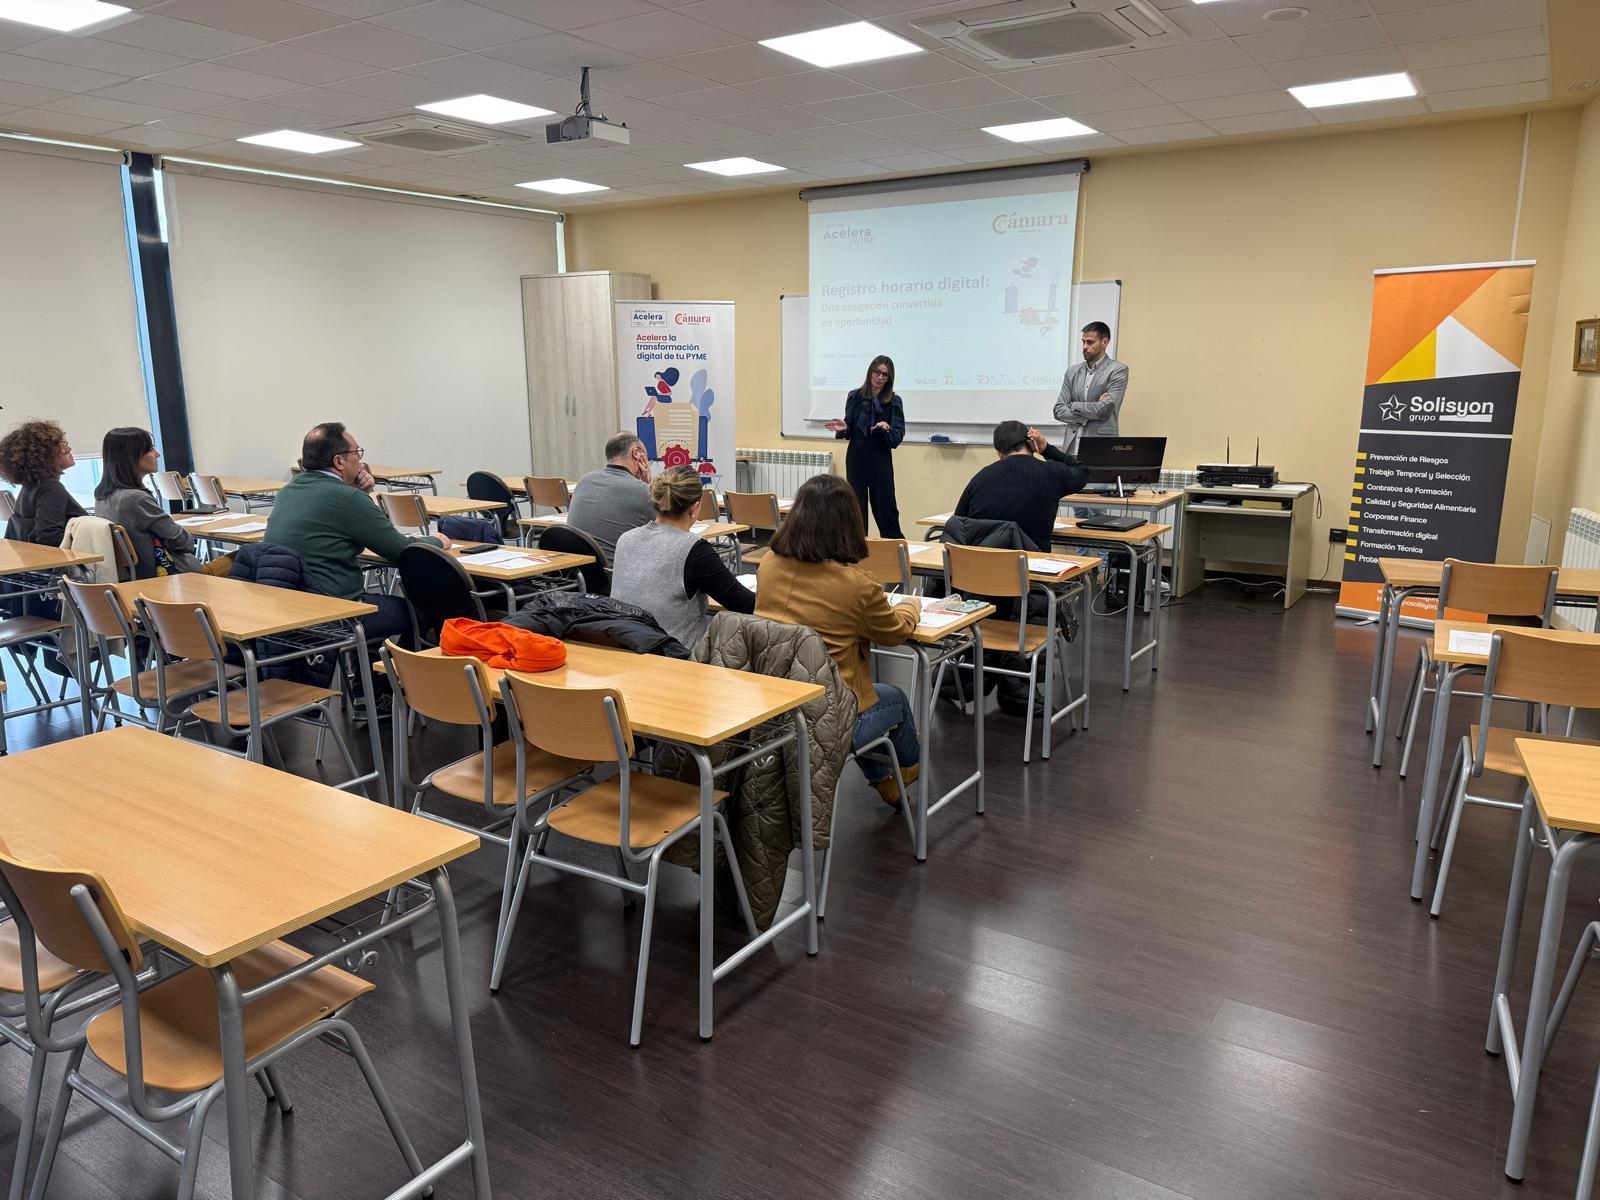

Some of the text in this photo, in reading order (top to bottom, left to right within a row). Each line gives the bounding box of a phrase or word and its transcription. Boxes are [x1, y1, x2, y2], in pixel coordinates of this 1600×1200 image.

[992, 211, 1070, 234] Cámara
[823, 226, 872, 240] Acelera
[822, 275, 991, 298] Registro horario digital:
[822, 298, 943, 313] Una obligación convertida
[633, 312, 663, 321] Acelera
[675, 313, 711, 324] Cámara
[835, 315, 893, 329] oportunidad
[636, 343, 699, 351] transformación
[636, 353, 662, 361] digital
[1410, 396, 1494, 417] Solisyon
[1409, 414, 1436, 423] grupo
[1370, 453, 1408, 462] Prevención
[1419, 456, 1449, 465] Riesgos
[1368, 467, 1394, 477] Trabajo
[1396, 469, 1428, 479] Temporal
[1435, 472, 1471, 482] Selección
[1366, 483, 1403, 493] Contratos
[1414, 487, 1453, 496] Formación
[1365, 497, 1391, 506] Calidad
[1397, 500, 1433, 509] Seguridad
[1434, 503, 1477, 513] Alimentaria
[1363, 511, 1428, 524] Corporate Finance
[1362, 526, 1438, 541] Transformación digital
[1360, 540, 1423, 554] Formación Técnica
[1358, 554, 1379, 564] Prote
